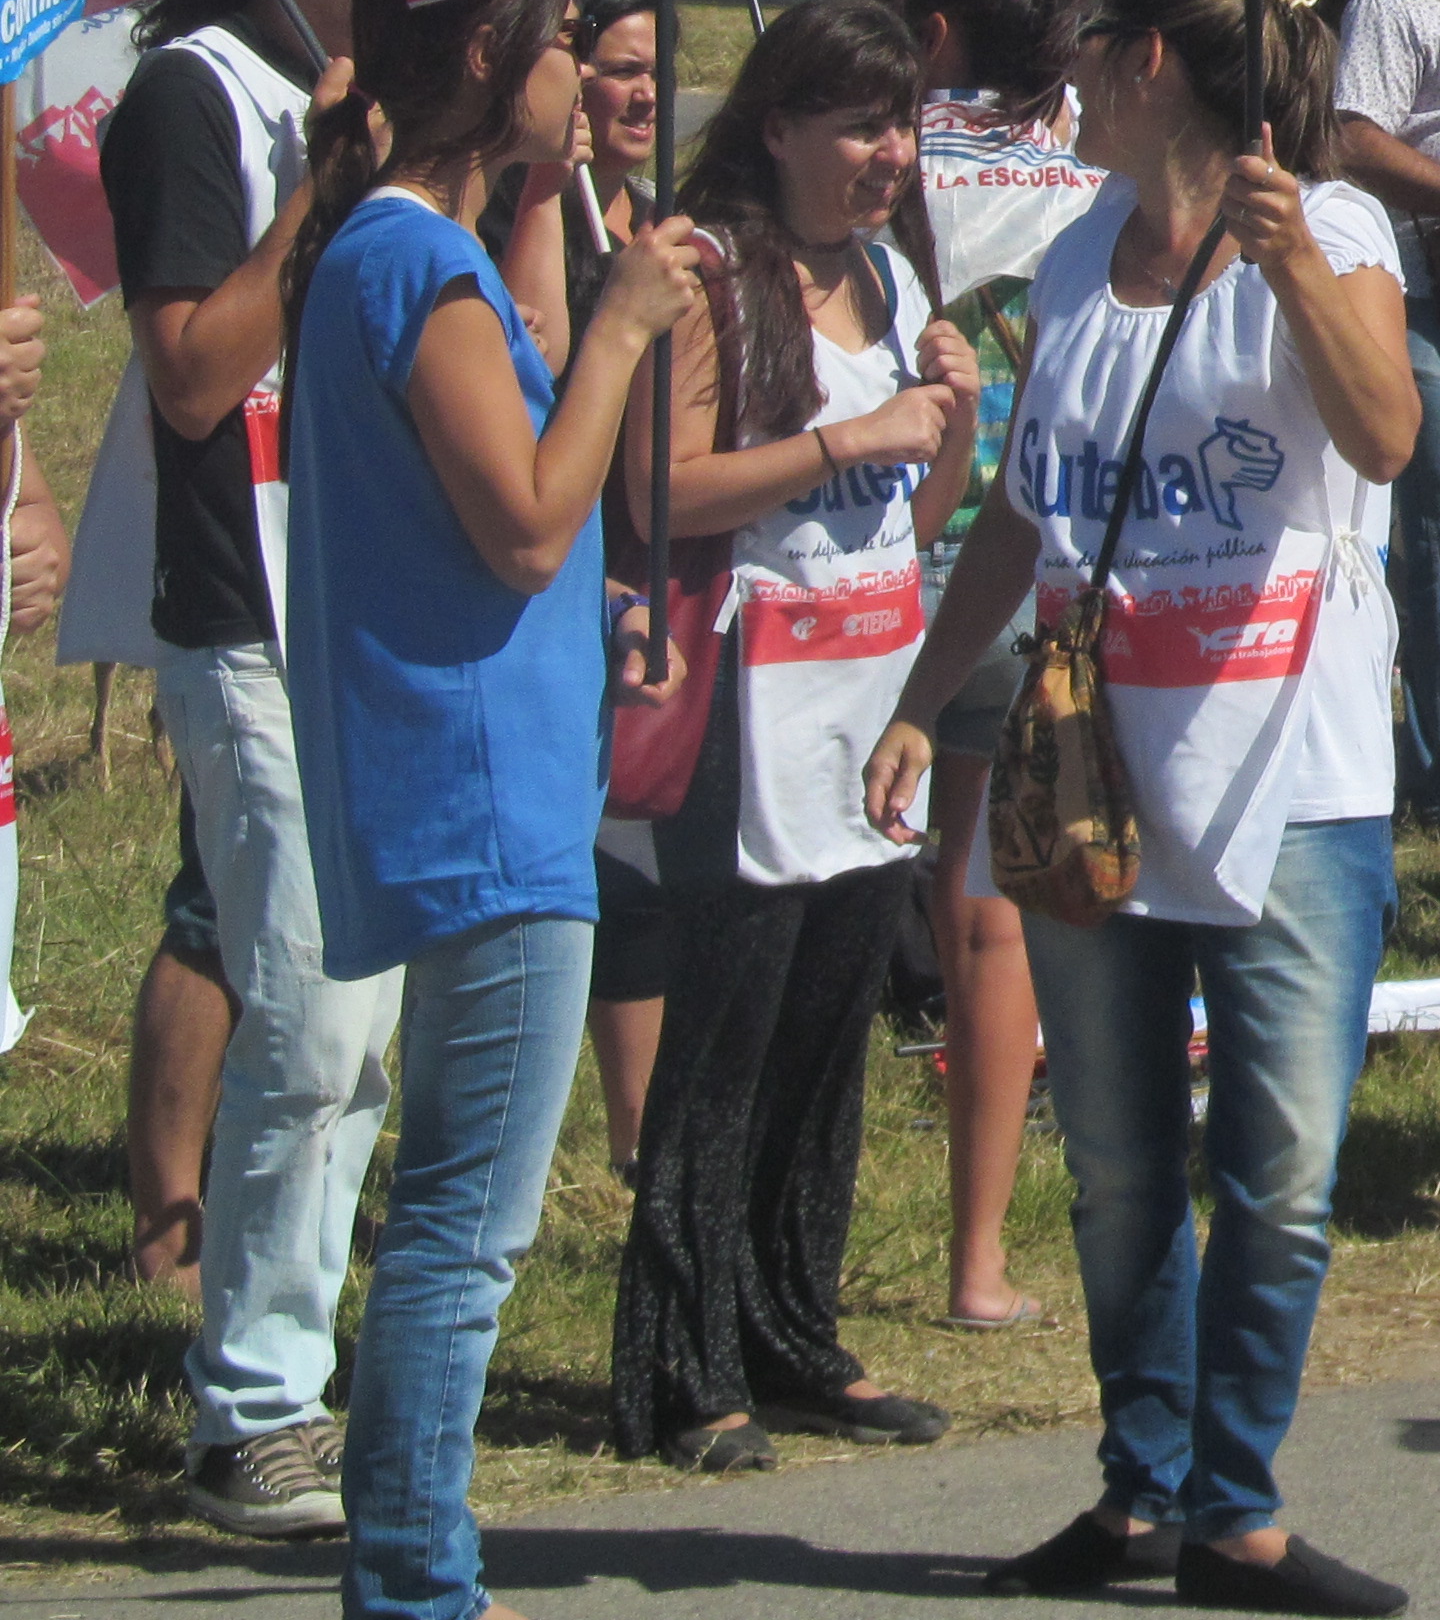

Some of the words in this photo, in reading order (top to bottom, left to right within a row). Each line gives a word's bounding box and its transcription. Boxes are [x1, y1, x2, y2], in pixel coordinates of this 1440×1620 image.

[936, 172, 970, 190] LA
[842, 606, 903, 637] CTERA
[1203, 617, 1299, 651] CTA
